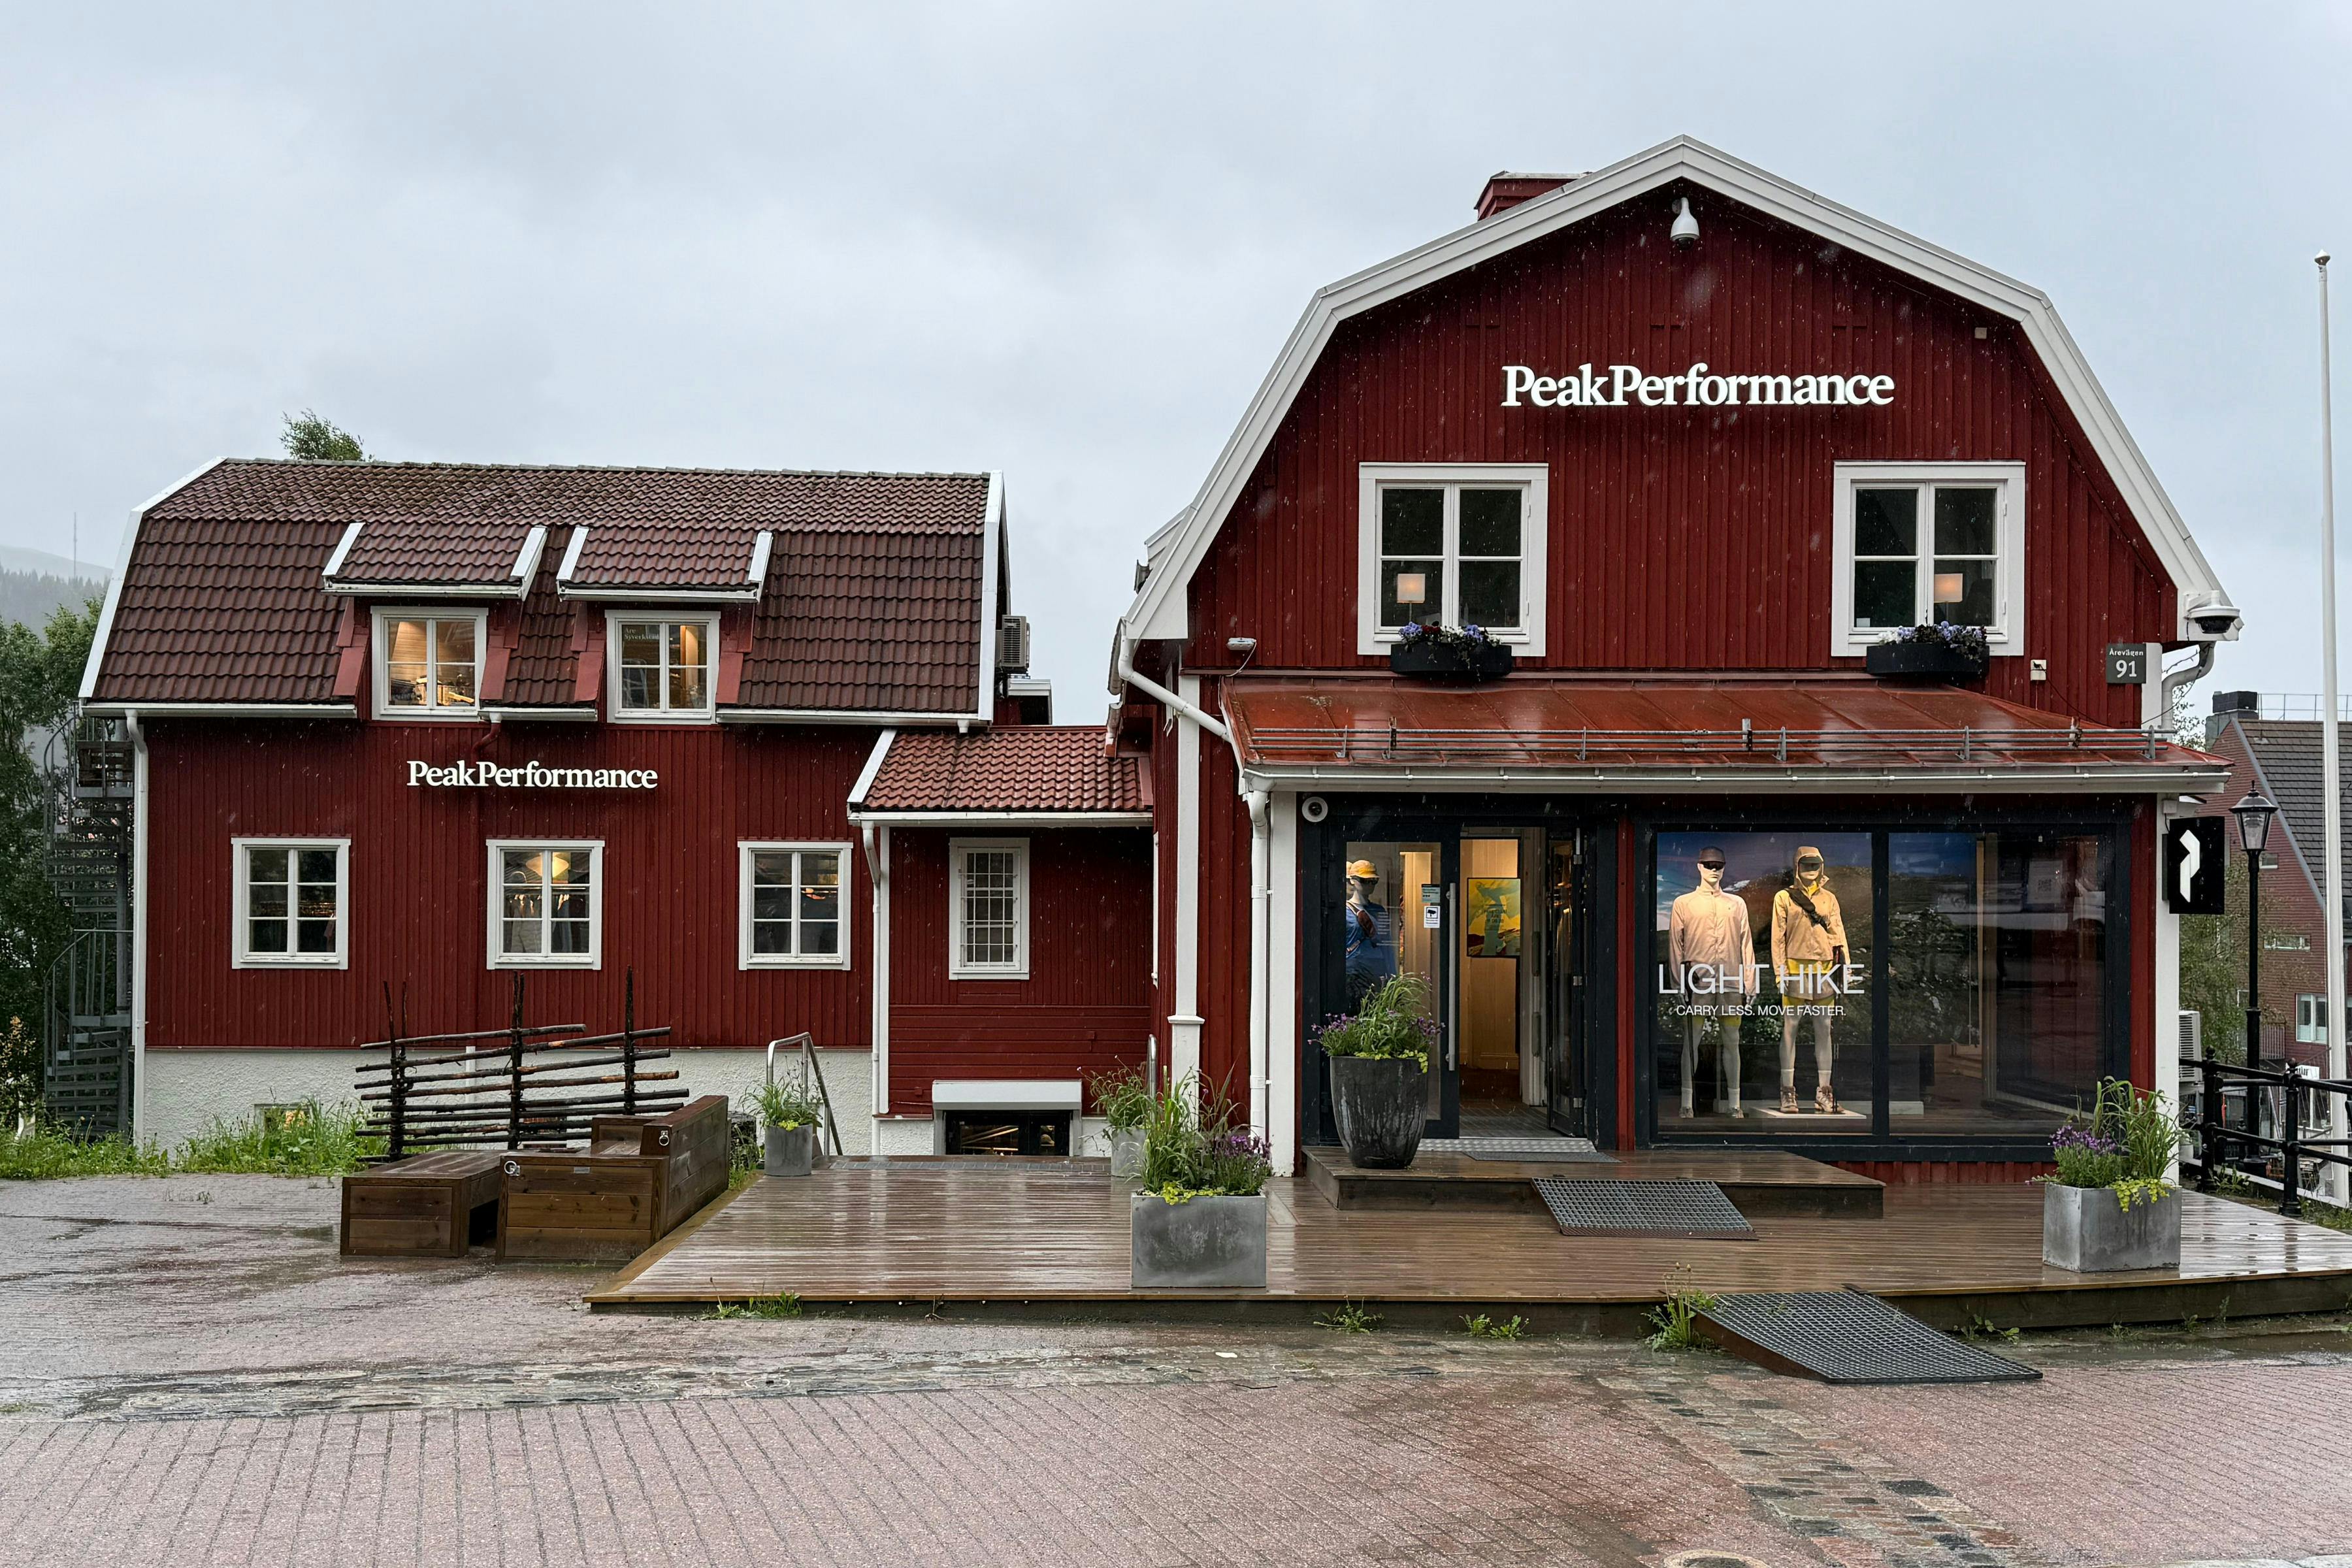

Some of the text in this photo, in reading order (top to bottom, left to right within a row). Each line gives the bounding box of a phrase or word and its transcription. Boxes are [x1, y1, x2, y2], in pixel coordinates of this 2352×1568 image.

[2109, 647, 2144, 657] Årevägen
[2115, 659, 2137, 678] 91
[1658, 963, 1865, 994] LIGHT HIKE
[1676, 1005, 1846, 1016] CARRY LESS. MOVE FASTER.
